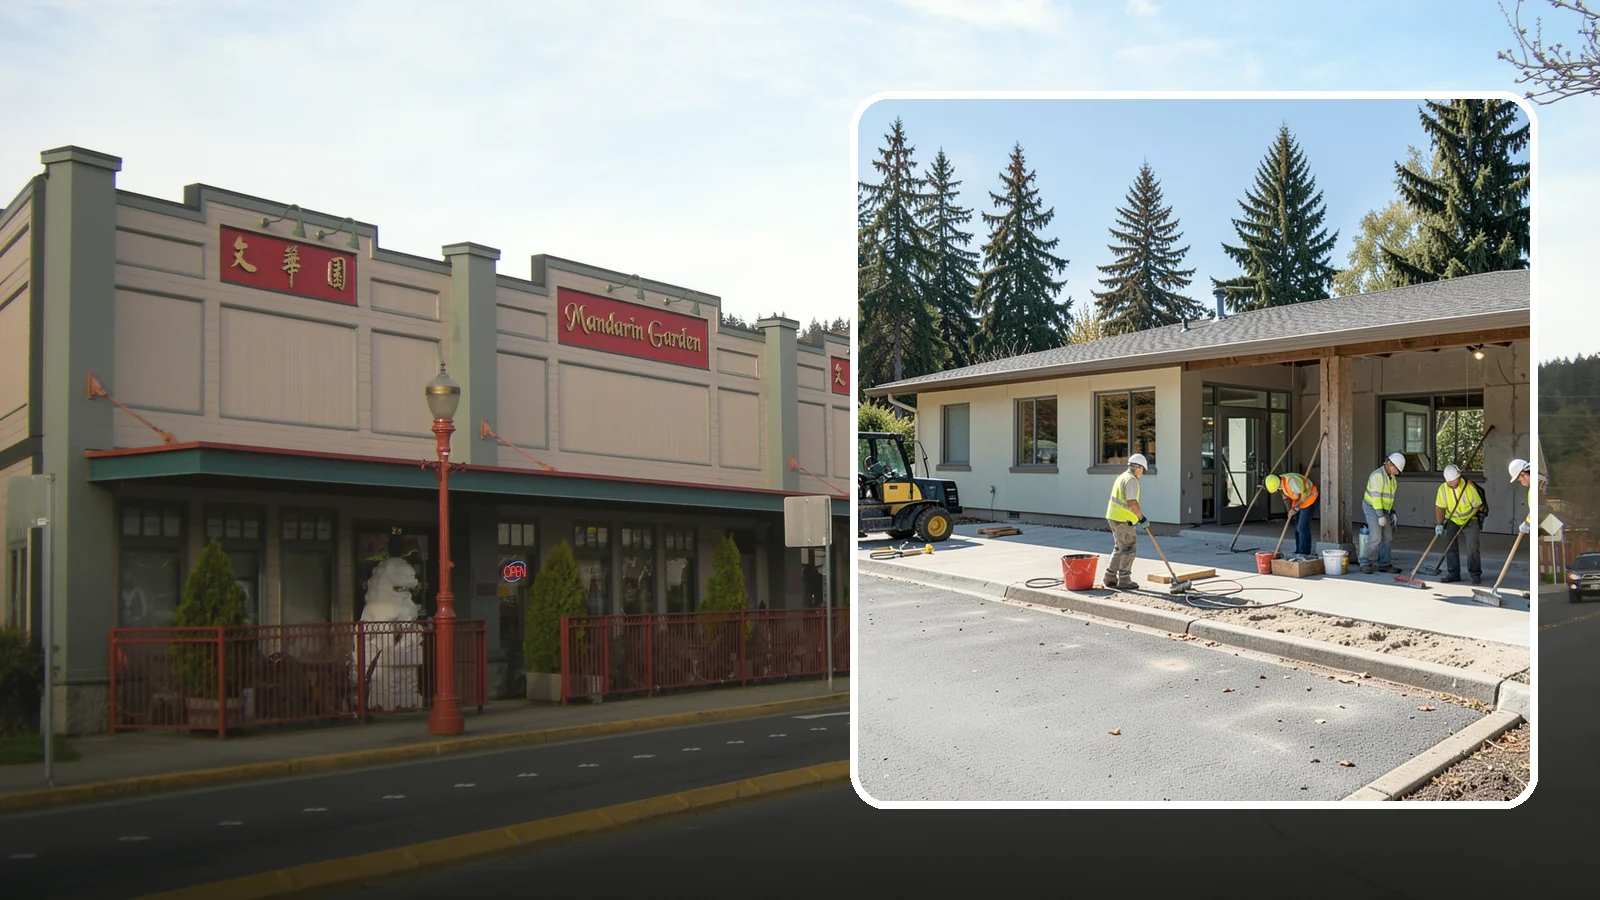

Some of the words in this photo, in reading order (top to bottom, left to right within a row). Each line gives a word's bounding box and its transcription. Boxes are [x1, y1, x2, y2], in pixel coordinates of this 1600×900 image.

[230, 235, 346, 291] 文華園
[564, 302, 644, 341] Mandarin
[648, 320, 701, 352] Garden
[503, 565, 527, 578] OPEN
